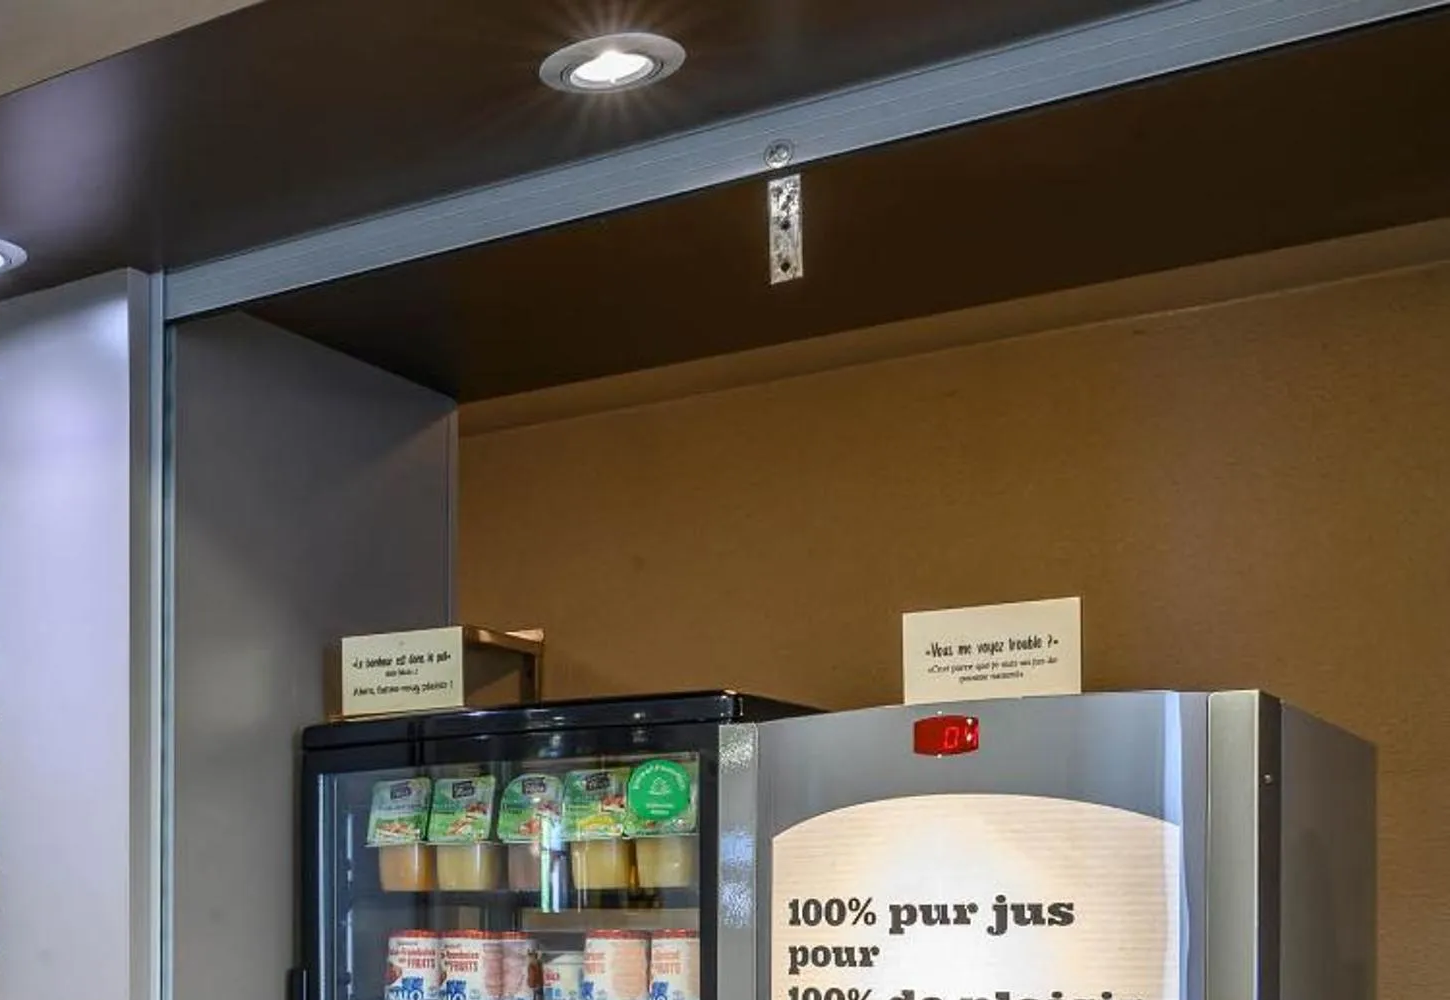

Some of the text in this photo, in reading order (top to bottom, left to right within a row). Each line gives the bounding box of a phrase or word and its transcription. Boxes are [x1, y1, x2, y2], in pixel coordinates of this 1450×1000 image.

[787, 894, 1076, 936] 100% pur jus
[788, 943, 881, 975] pour
